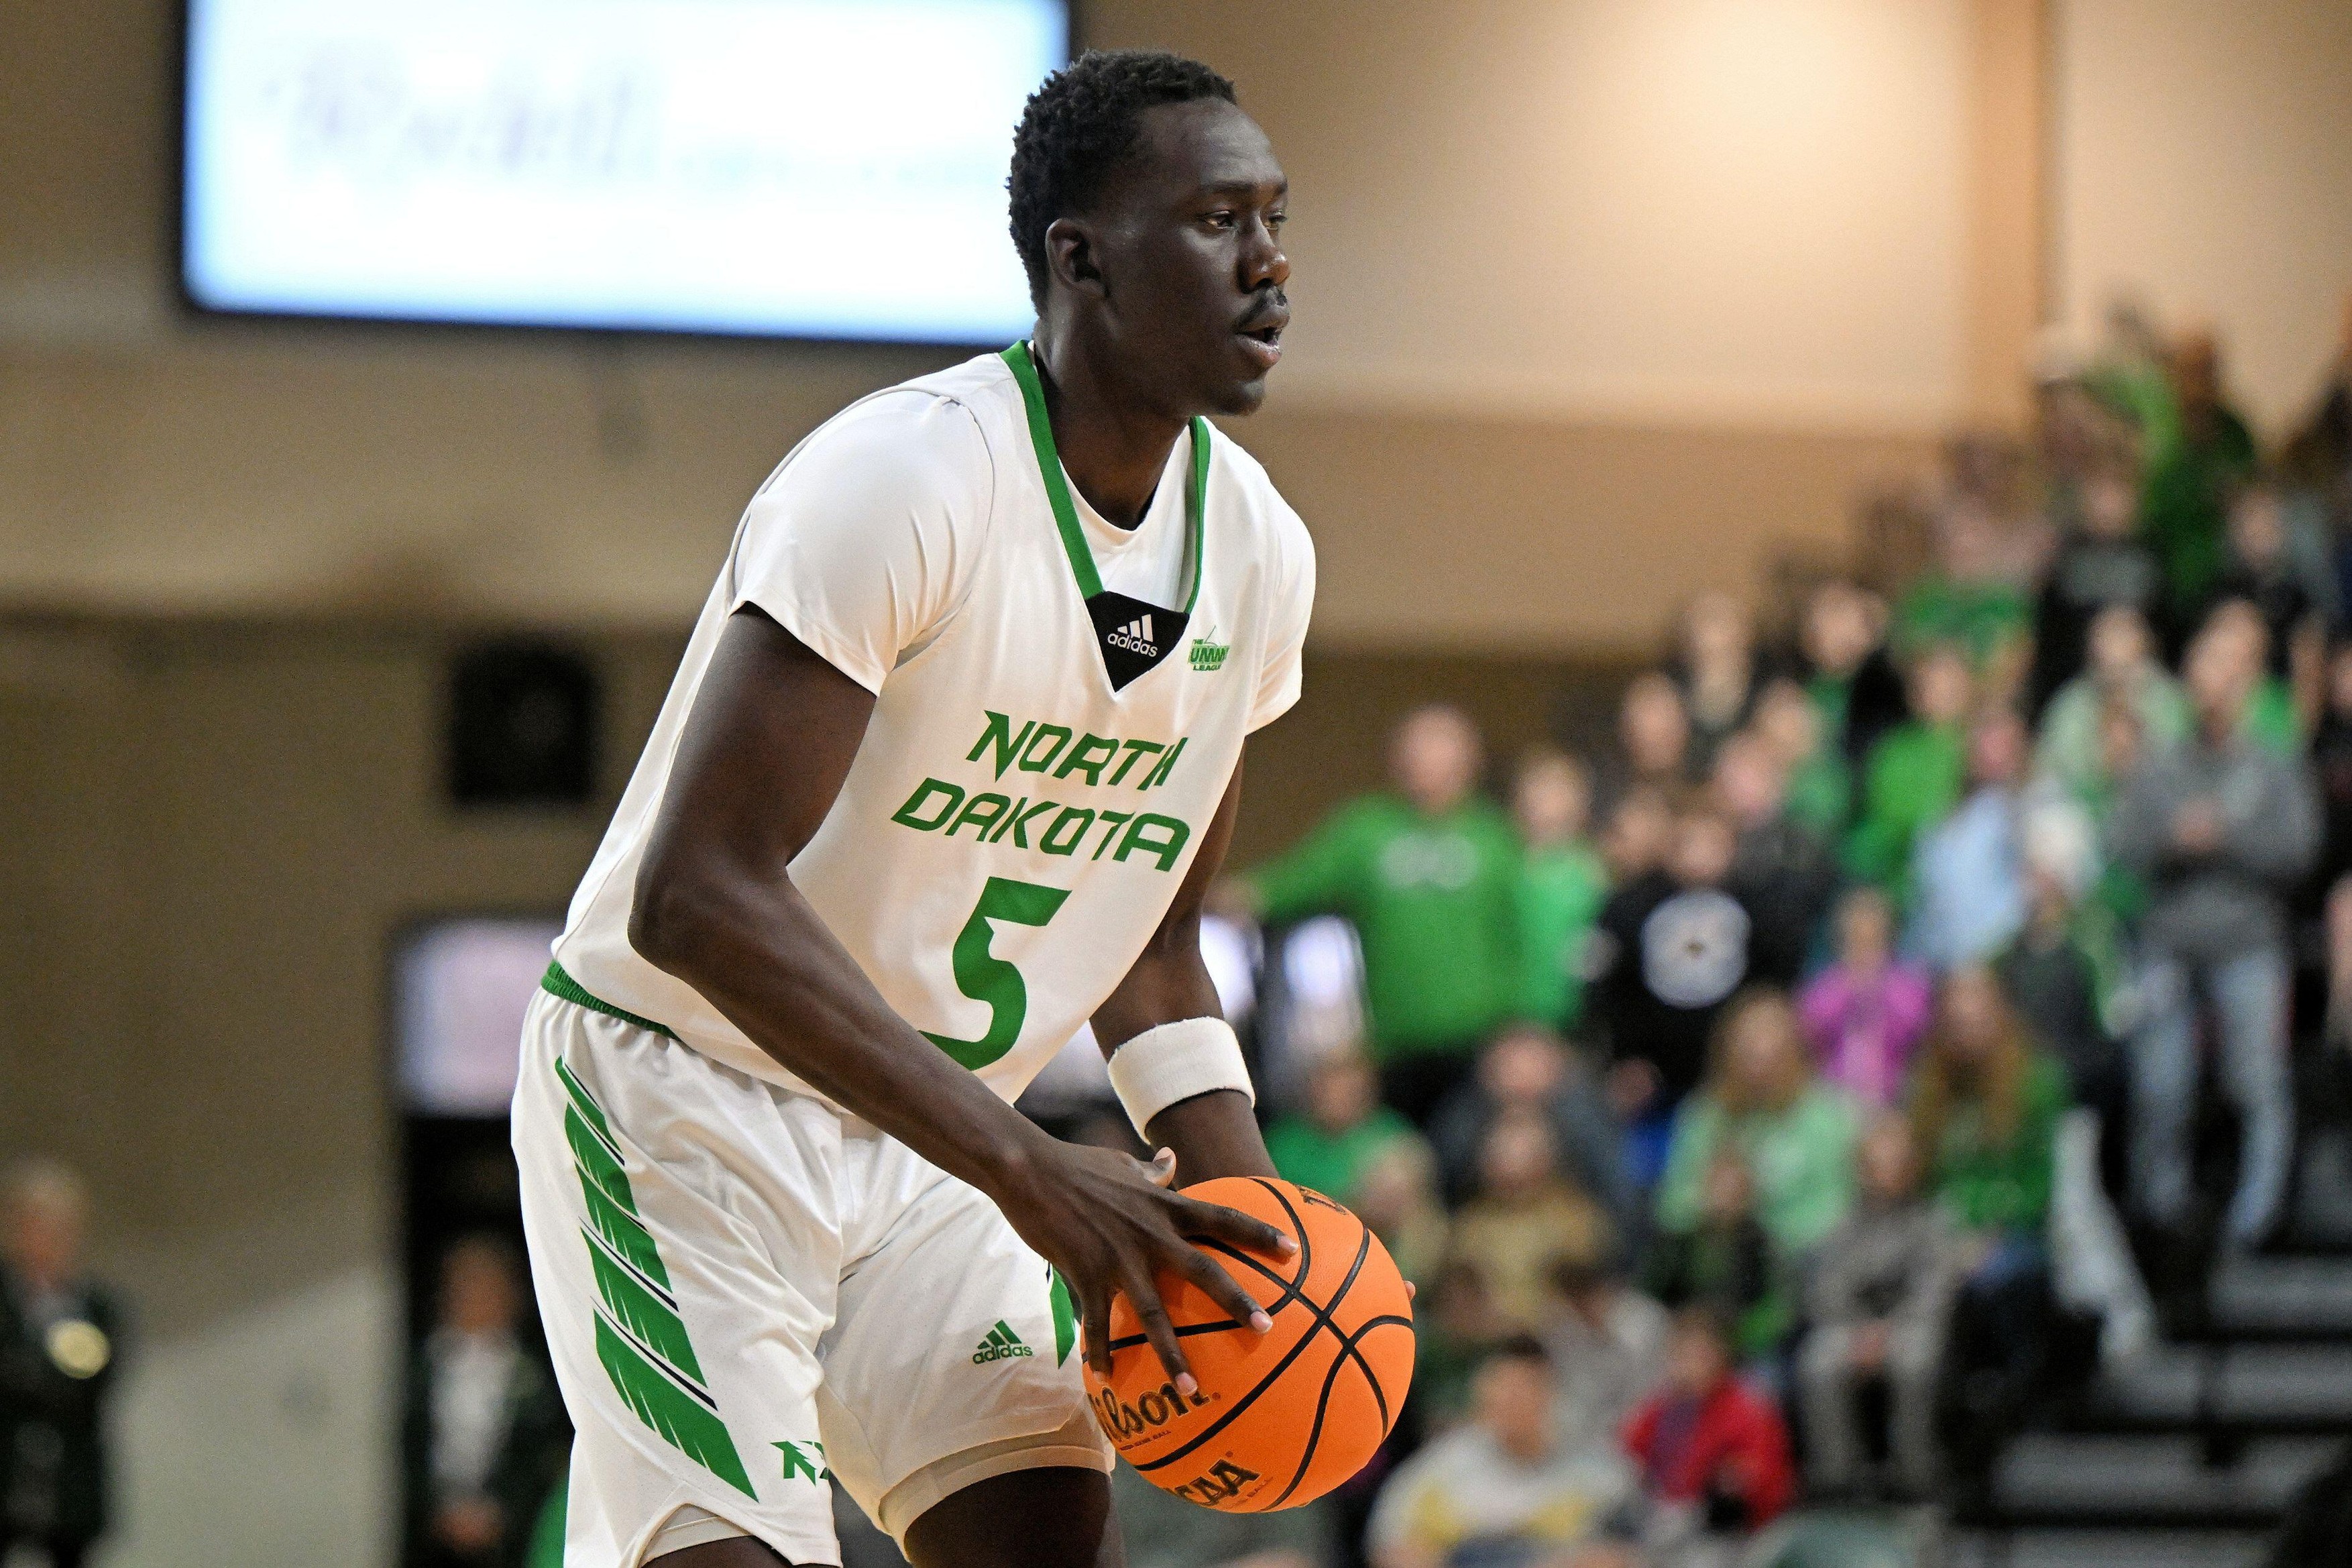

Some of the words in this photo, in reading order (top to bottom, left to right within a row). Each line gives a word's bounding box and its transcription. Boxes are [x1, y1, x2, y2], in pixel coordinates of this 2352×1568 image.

[1107, 633, 1158, 657] adidas
[966, 710, 1188, 791] NORTH
[891, 777, 1190, 873] DAKOTA
[917, 876, 1072, 1072] 5
[972, 1344, 1033, 1364] adidas
[1087, 1382, 1211, 1443] ilson
[1166, 1458, 1261, 1506] CAA
